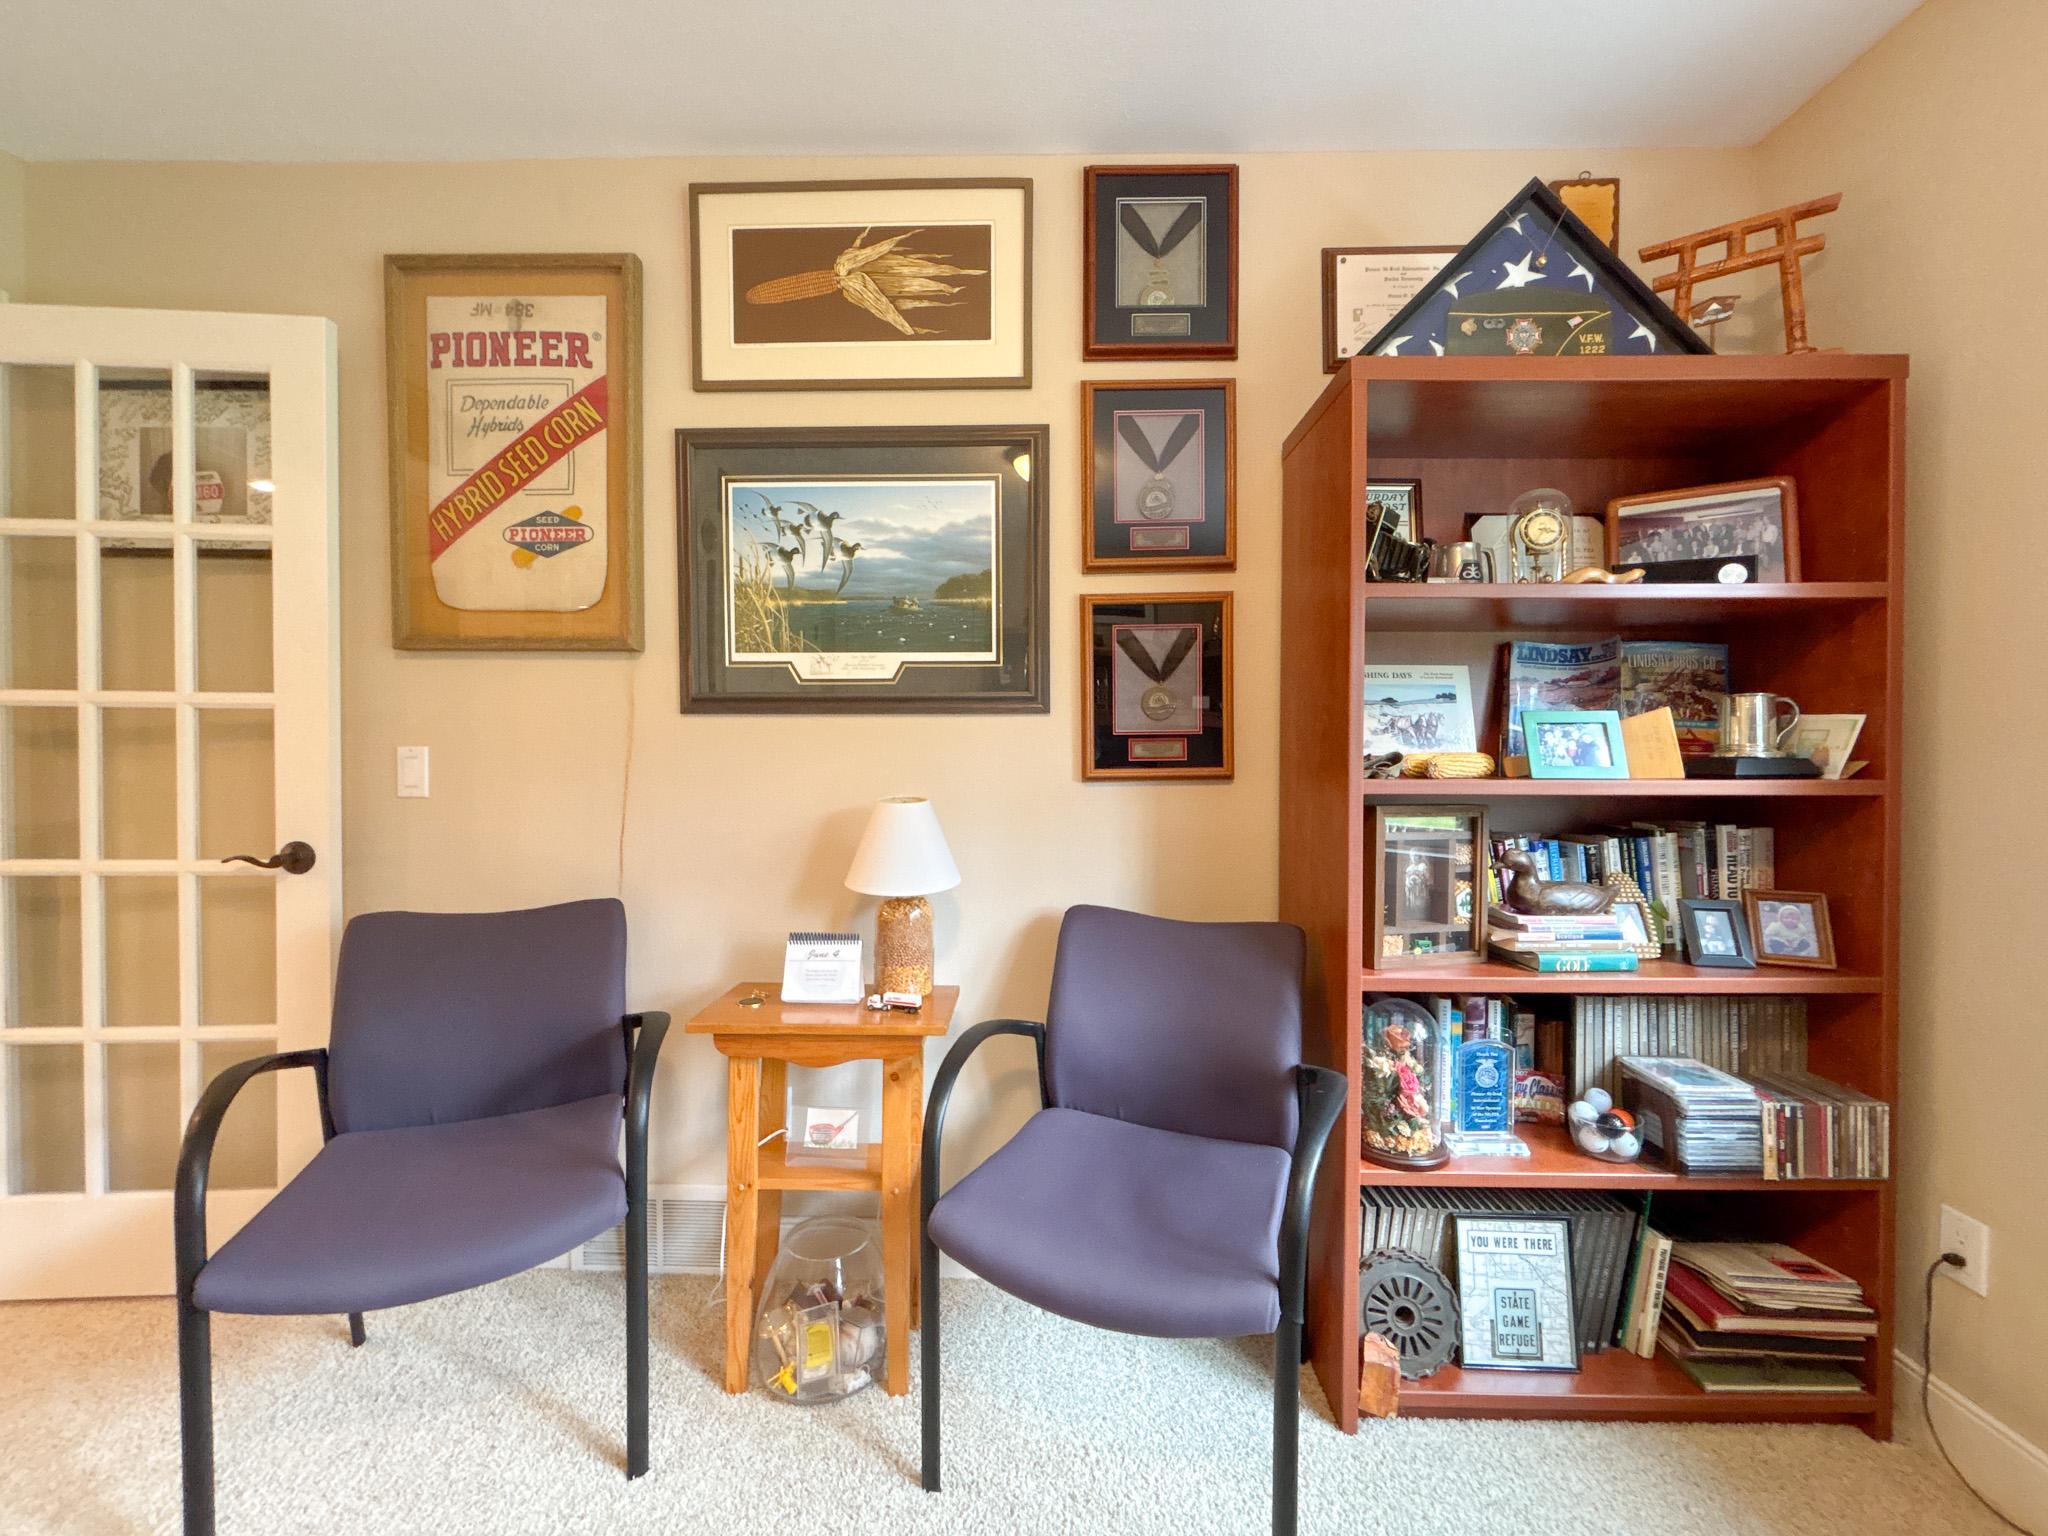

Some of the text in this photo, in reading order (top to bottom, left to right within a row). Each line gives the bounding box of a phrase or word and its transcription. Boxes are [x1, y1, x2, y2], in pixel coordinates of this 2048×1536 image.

[430, 331, 593, 369] PIONEER
[1579, 345, 1606, 354] 1222
[460, 395, 550, 414] Dependable
[467, 415, 525, 440] Hybrids
[431, 395, 604, 542] HYBRID SEED CORN
[536, 516, 560, 524] SEED
[508, 528, 586, 542] PIONEER
[534, 543, 560, 551] CORN
[1517, 645, 1593, 662] LINDSAY
[1627, 653, 1670, 668] LINDSAY
[1392, 672, 1413, 680] DAYS
[1556, 958, 1591, 972] GOLF
[1470, 1236, 1553, 1251] YOU WERE THERE
[1500, 1296, 1530, 1310] STATE
[1502, 1315, 1530, 1328] GAME
[1499, 1333, 1536, 1347] REFUGE
